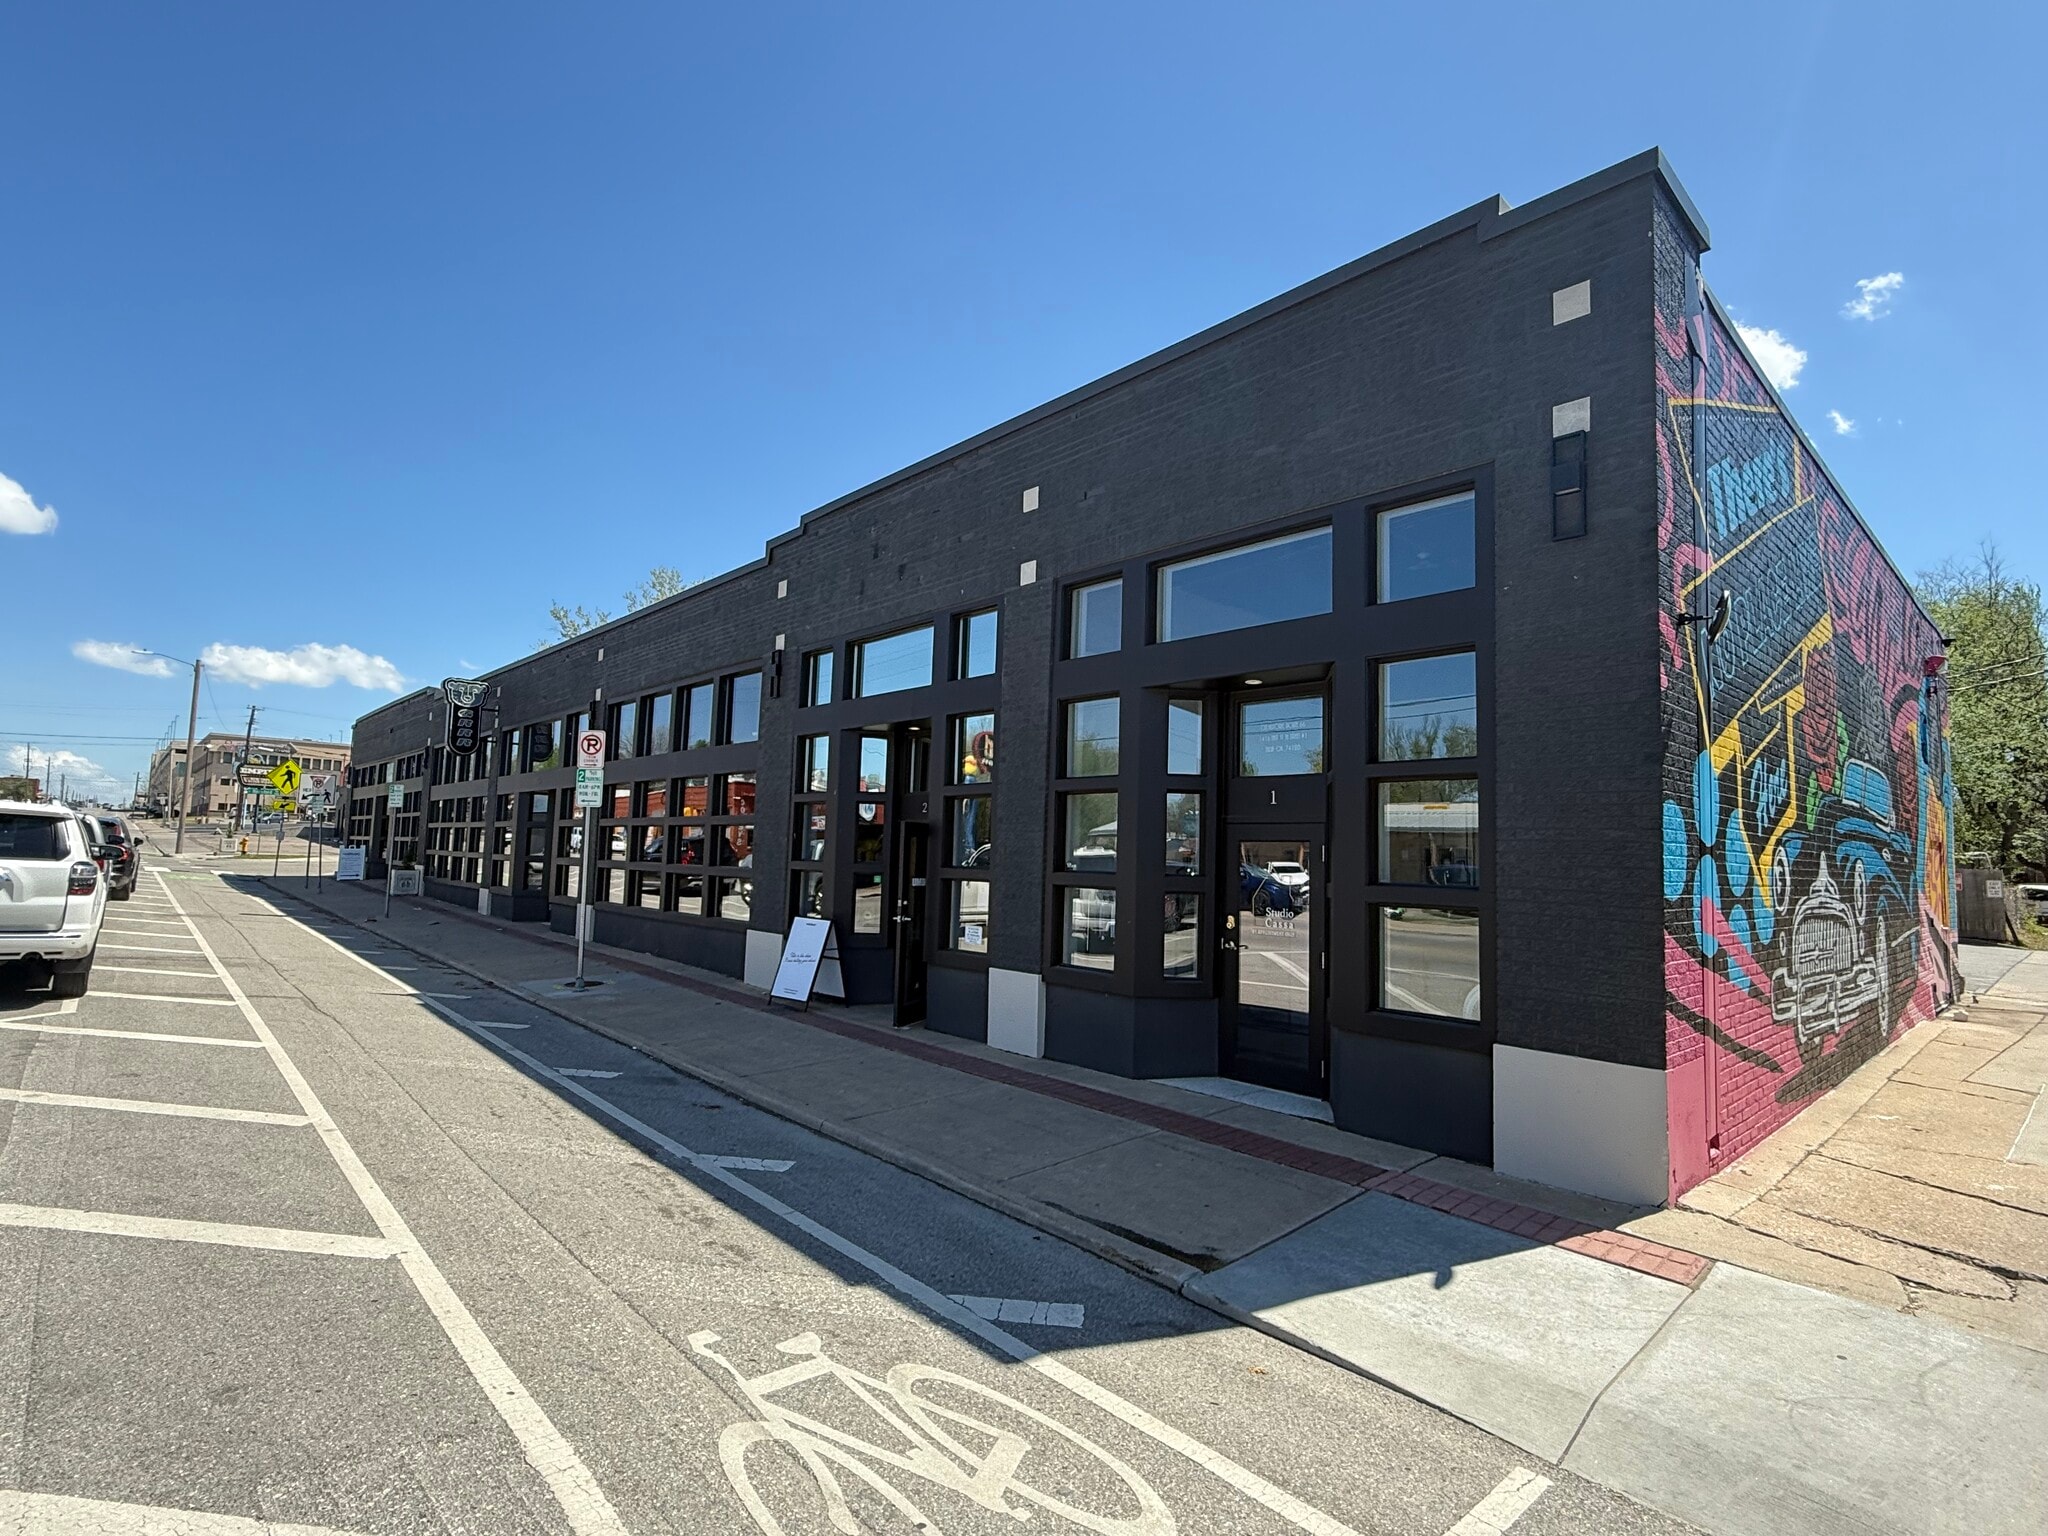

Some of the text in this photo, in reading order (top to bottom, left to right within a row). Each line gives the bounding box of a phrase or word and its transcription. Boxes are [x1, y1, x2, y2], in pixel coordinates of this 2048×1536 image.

[1707, 438, 1790, 541] There's
[456, 708, 474, 747] GRRR
[579, 771, 585, 782] 2
[1270, 790, 1277, 805] 1
[922, 802, 928, 813] 2
[1265, 907, 1294, 919] Studio
[1265, 918, 1294, 930] Cassa
